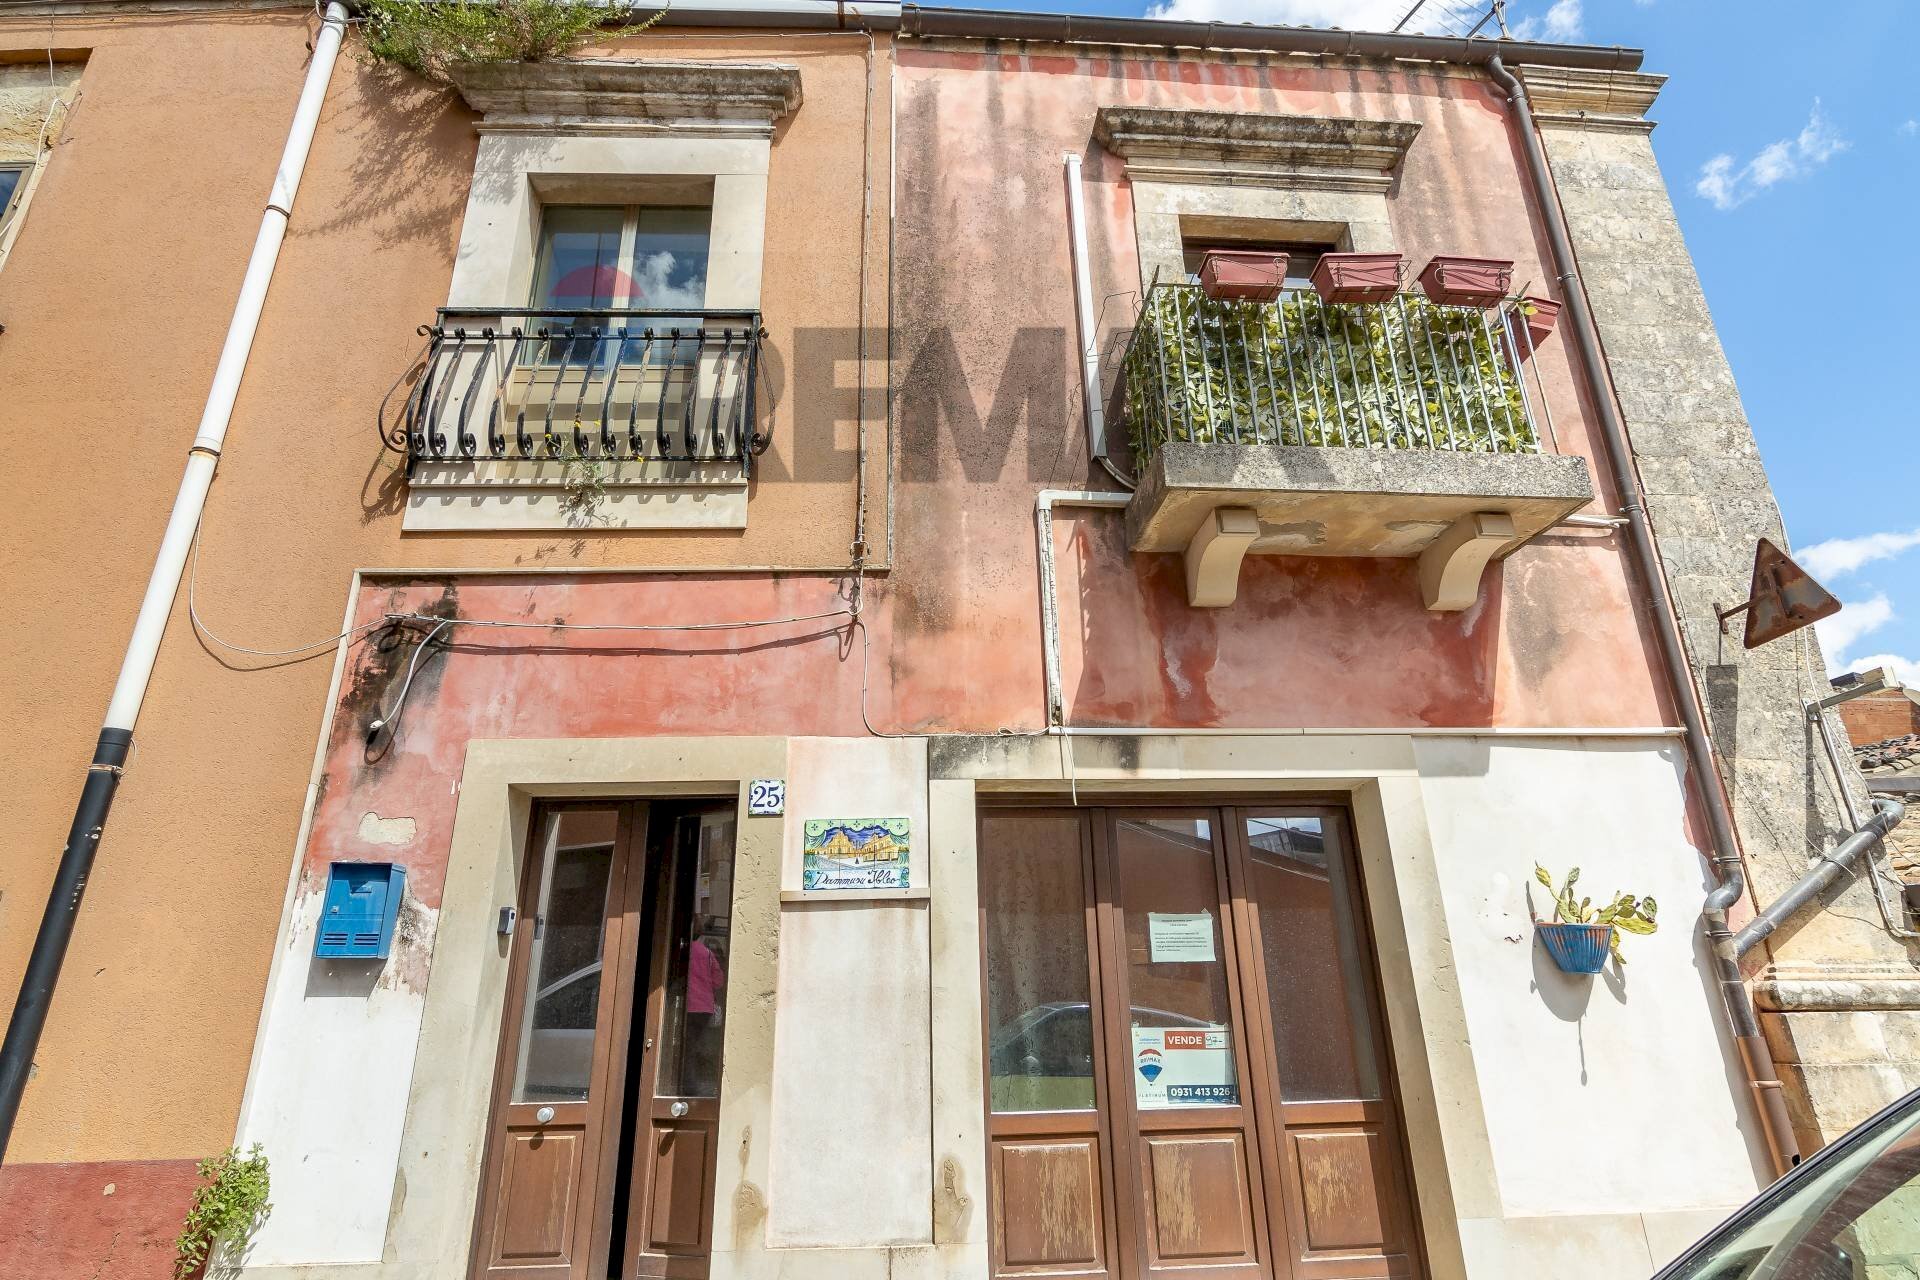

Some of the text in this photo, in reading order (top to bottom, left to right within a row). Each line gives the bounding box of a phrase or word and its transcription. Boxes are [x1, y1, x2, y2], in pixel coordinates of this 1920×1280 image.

[752, 785, 780, 808] 25
[1167, 1035, 1203, 1045] VENDE
[1170, 1087, 1230, 1097] 0931 413 926
